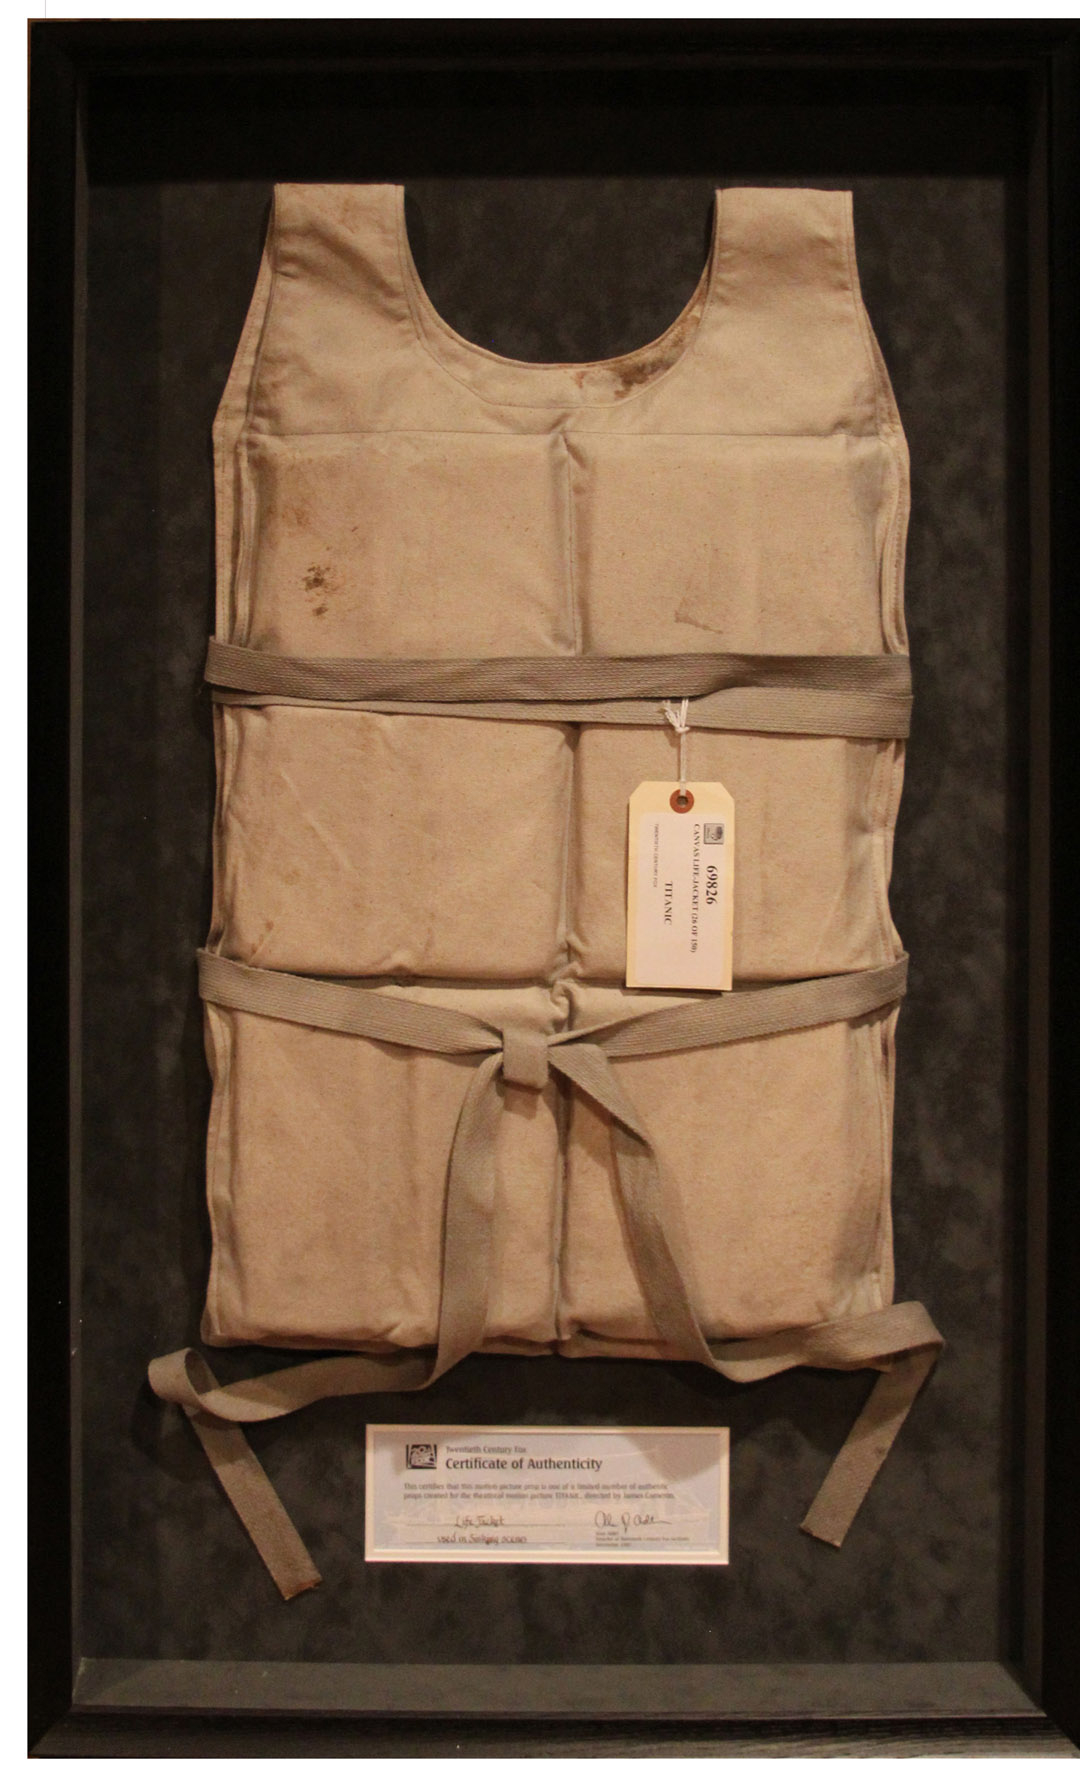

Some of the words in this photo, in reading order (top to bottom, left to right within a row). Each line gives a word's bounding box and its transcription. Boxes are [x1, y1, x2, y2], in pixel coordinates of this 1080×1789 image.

[692, 823, 701, 857] CANVAS
[691, 859, 700, 912] LIFE-JACKET
[705, 865, 718, 905] 69826
[664, 881, 673, 926] TITANIC
[691, 925, 698, 937] OF
[445, 1458, 507, 1470] Certificate
[511, 1457, 524, 1470] of
[527, 1458, 602, 1472] Authenticity
[482, 1446, 512, 1455] Century
